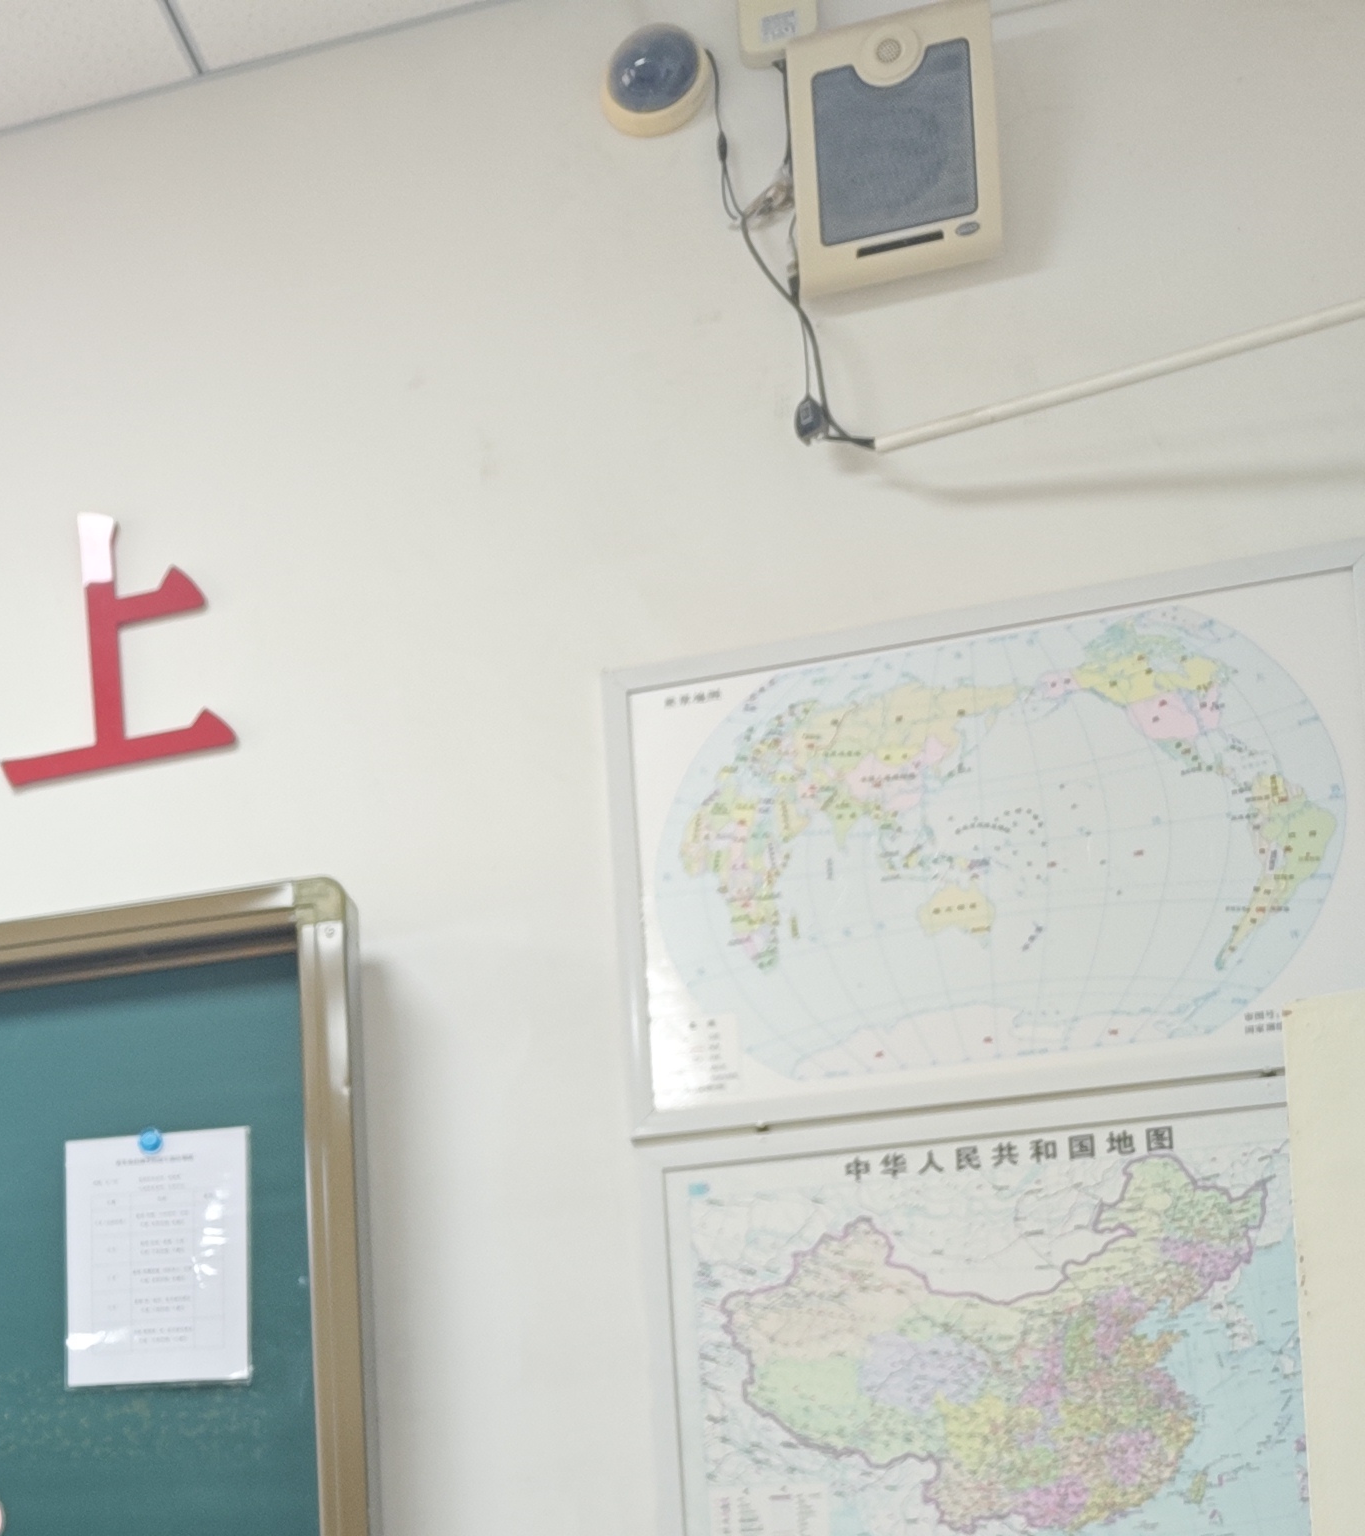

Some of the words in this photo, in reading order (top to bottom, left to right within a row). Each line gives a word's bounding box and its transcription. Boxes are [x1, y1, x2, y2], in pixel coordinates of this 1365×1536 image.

[844, 1126, 1174, 1183] 中华人民共和国地图
